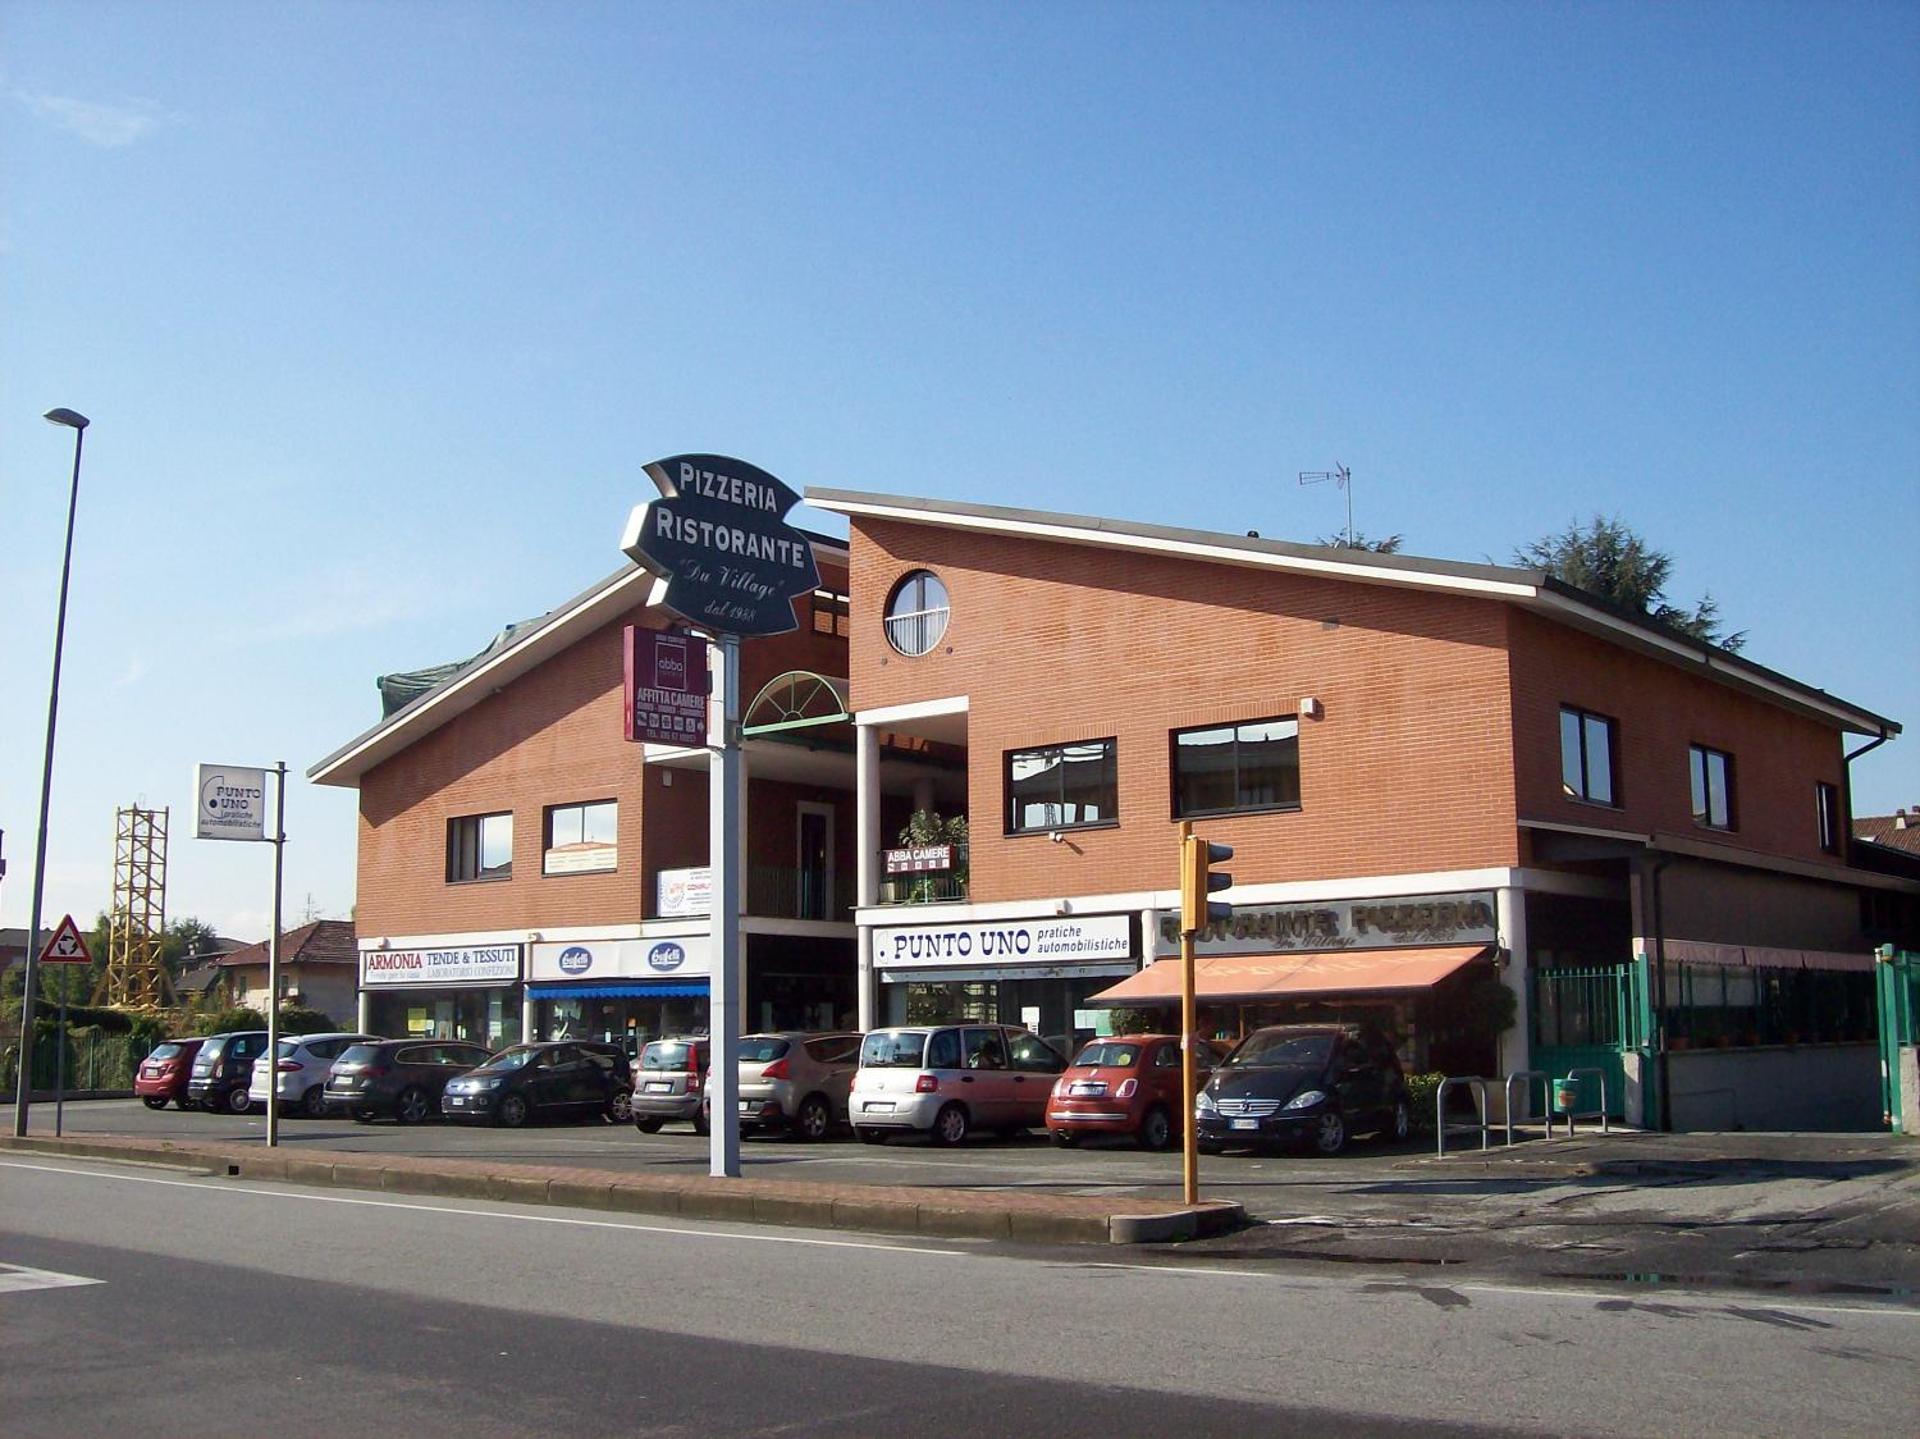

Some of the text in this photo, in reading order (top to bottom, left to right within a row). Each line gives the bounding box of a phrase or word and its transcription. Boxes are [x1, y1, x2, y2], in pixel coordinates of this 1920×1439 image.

[680, 462, 777, 513] PIZZERIA
[657, 507, 805, 568] RISTORANTE
[217, 786, 261, 799] PUNTO
[221, 799, 248, 810] UNO
[888, 847, 949, 862] ABBA CAMERE
[1037, 926, 1082, 943] pratiche
[894, 929, 1031, 959] PUNTO UNO
[1037, 938, 1128, 954] automobilistiche
[368, 953, 422, 970] ARMONIA
[427, 948, 515, 966] TENDE & TESSUTI
